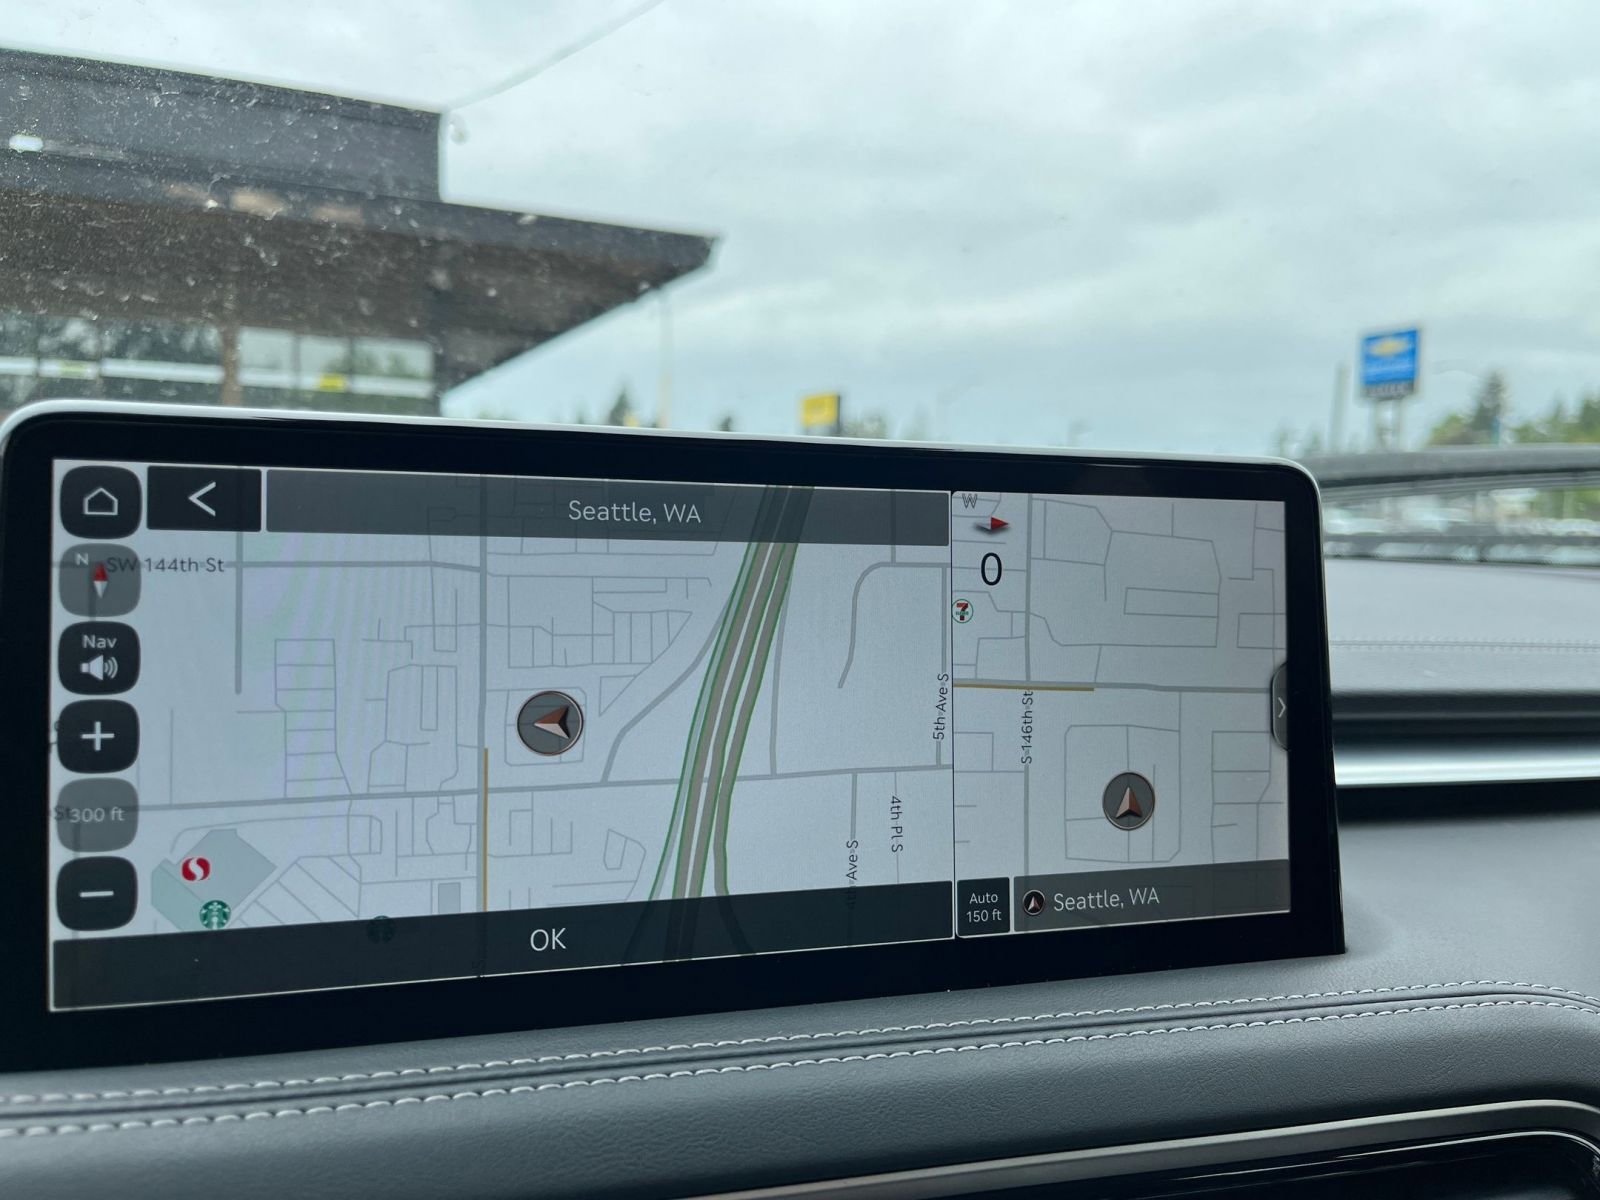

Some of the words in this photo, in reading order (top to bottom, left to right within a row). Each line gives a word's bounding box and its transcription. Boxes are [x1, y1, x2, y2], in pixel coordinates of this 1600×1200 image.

[962, 493, 978, 509] W
[568, 499, 658, 525] Seattle,
[663, 503, 702, 523] WA
[75, 552, 89, 565] N
[107, 557, 137, 573] SW
[144, 557, 199, 573] 144th
[205, 557, 225, 573] St
[980, 552, 1003, 586] 0
[82, 634, 118, 649] Nav
[937, 672, 949, 682] S
[935, 686, 949, 713] Ave
[1022, 690, 1034, 705] St
[932, 716, 946, 740] 5th
[1021, 709, 1033, 751] 146th
[1021, 755, 1033, 765] S
[69, 807, 105, 823] 300
[110, 806, 126, 822] ft
[890, 796, 903, 821] 4th
[891, 825, 903, 839] Pl
[846, 839, 859, 849] S
[891, 844, 904, 853] S
[846, 855, 858, 881] Ave
[969, 892, 999, 905] Auto
[1053, 889, 1125, 912] Seattle,
[1128, 886, 1161, 905] WA
[966, 910, 989, 924] 150
[992, 908, 1002, 921] ft
[530, 927, 567, 951] OK
